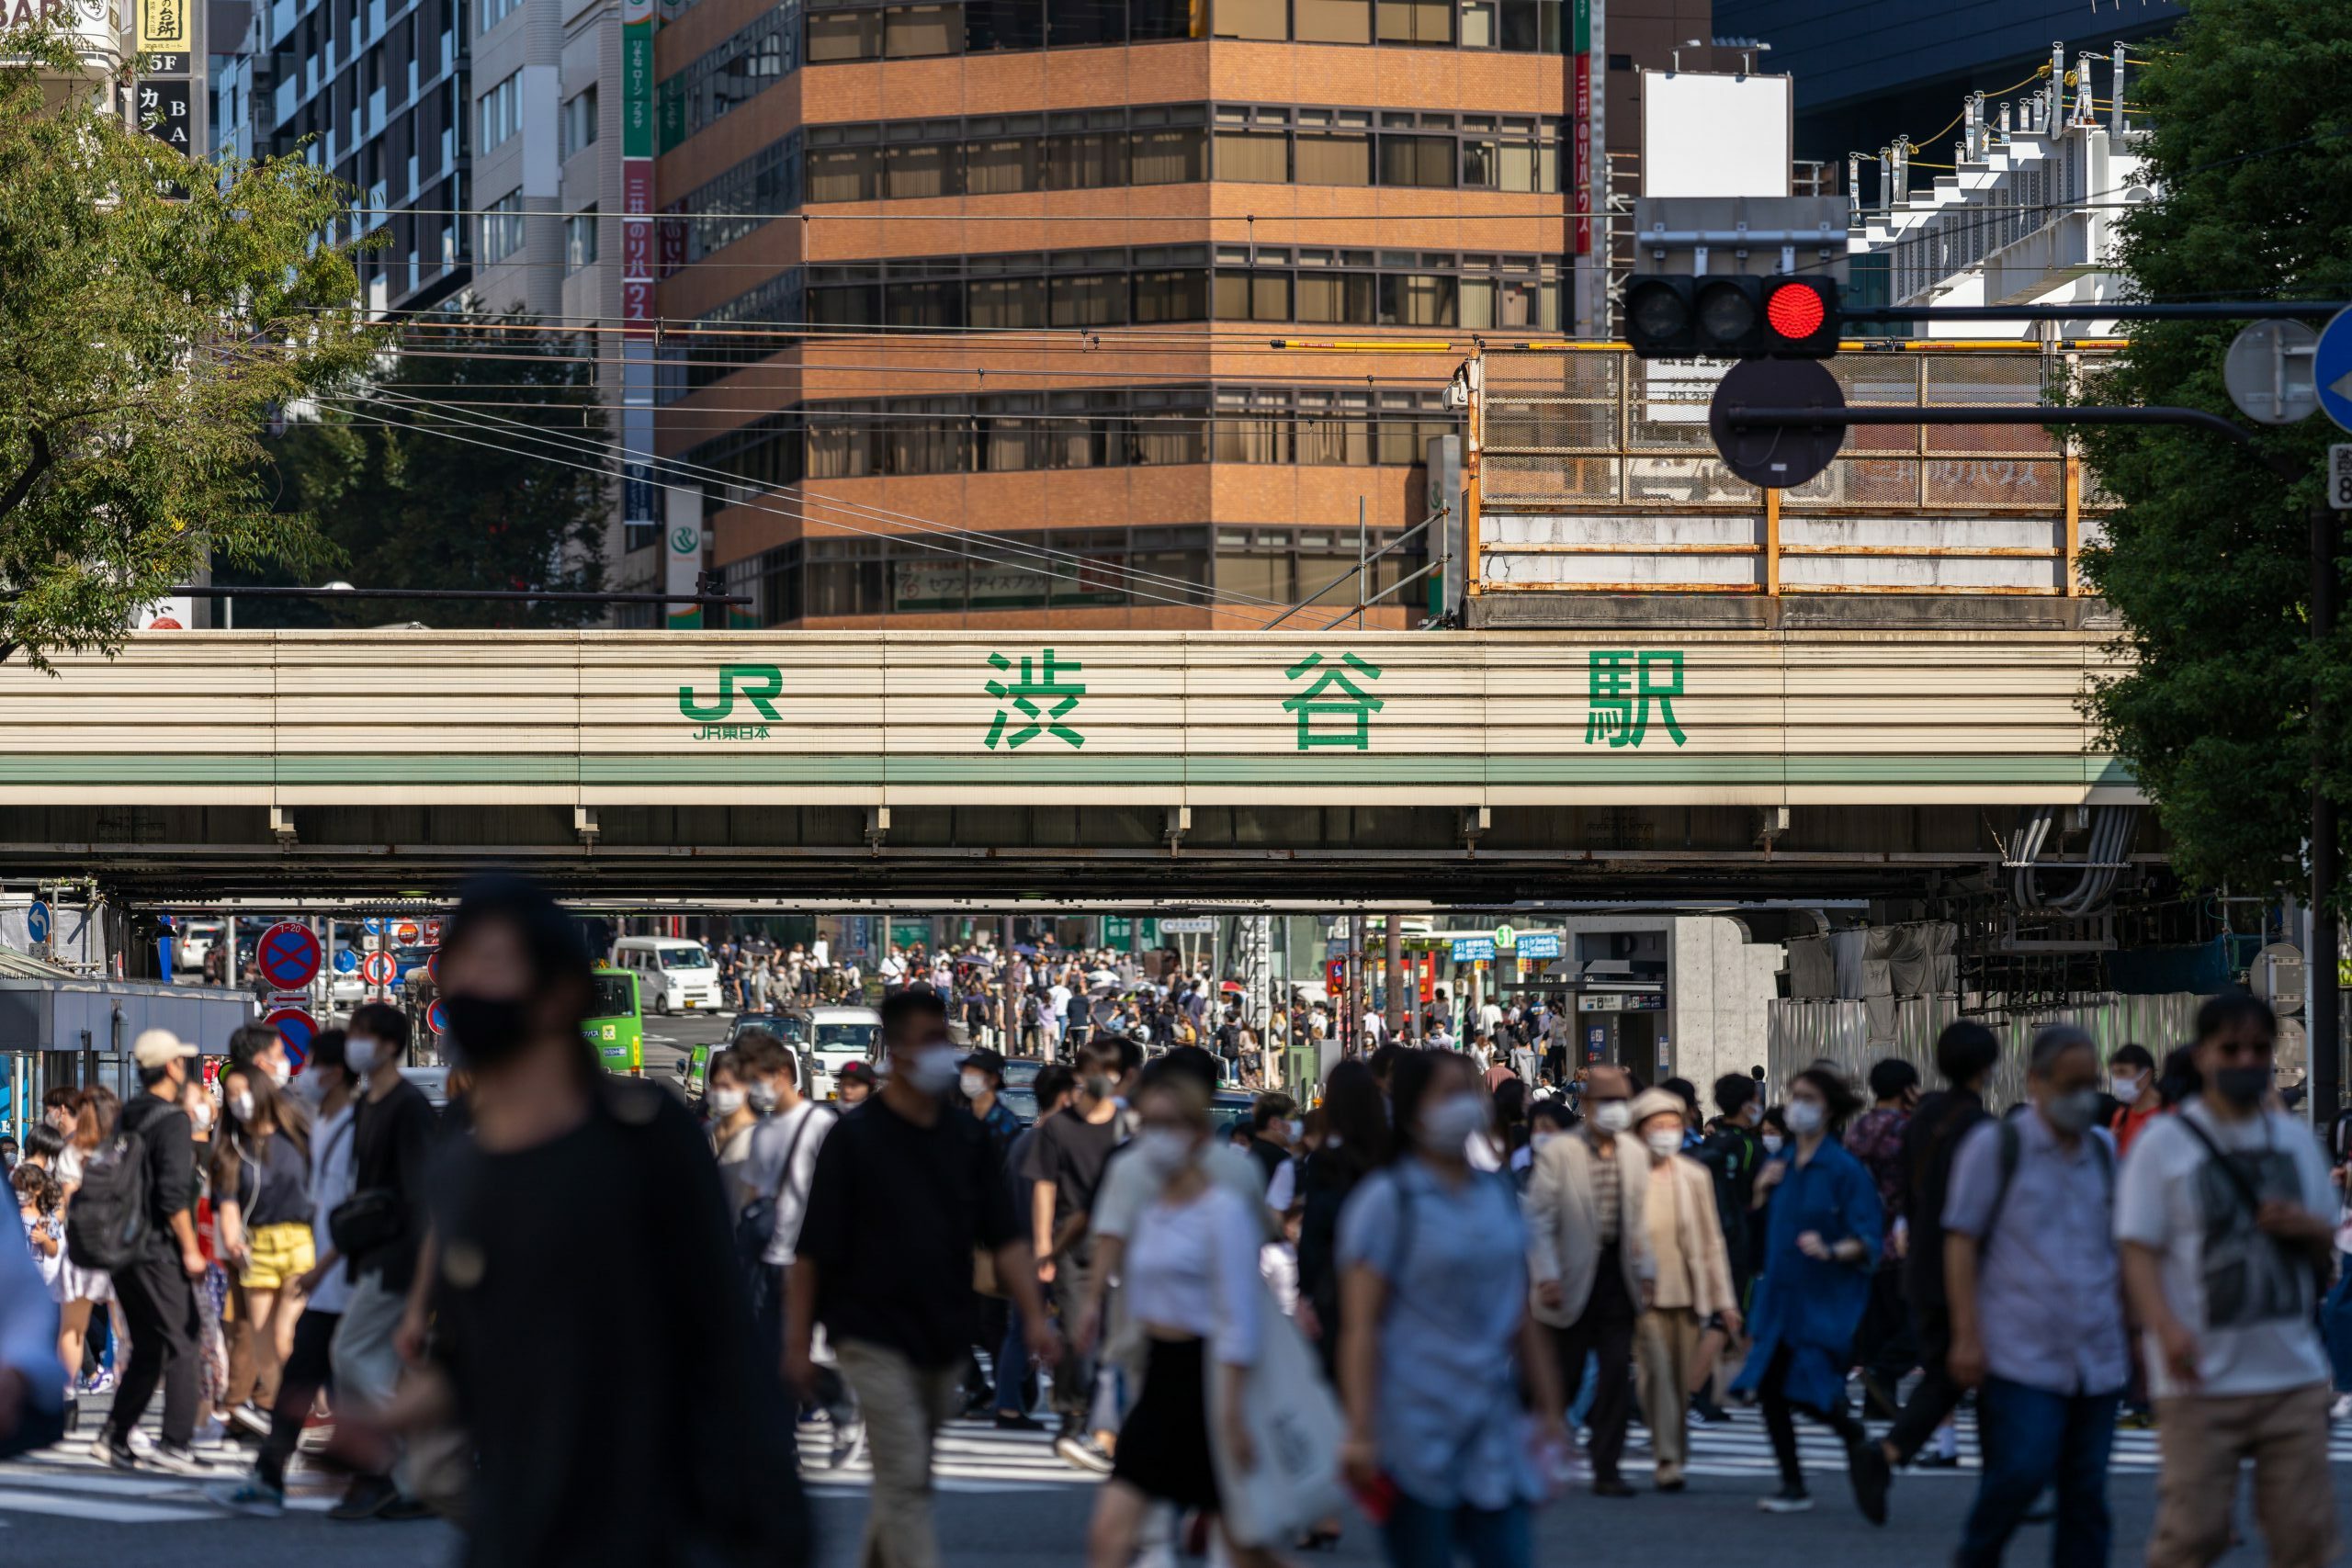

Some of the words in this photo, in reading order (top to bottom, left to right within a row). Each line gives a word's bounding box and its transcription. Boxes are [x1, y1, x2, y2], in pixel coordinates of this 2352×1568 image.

[150, 54, 176, 71] 5F
[1578, 74, 1589, 232] 三井のリハウス
[628, 179, 647, 319] 三井のリハウス
[679, 663, 784, 721] JR
[693, 724, 771, 740] JR東日本
[278, 923, 301, 933] 7-20
[1498, 928, 1512, 945] 51
